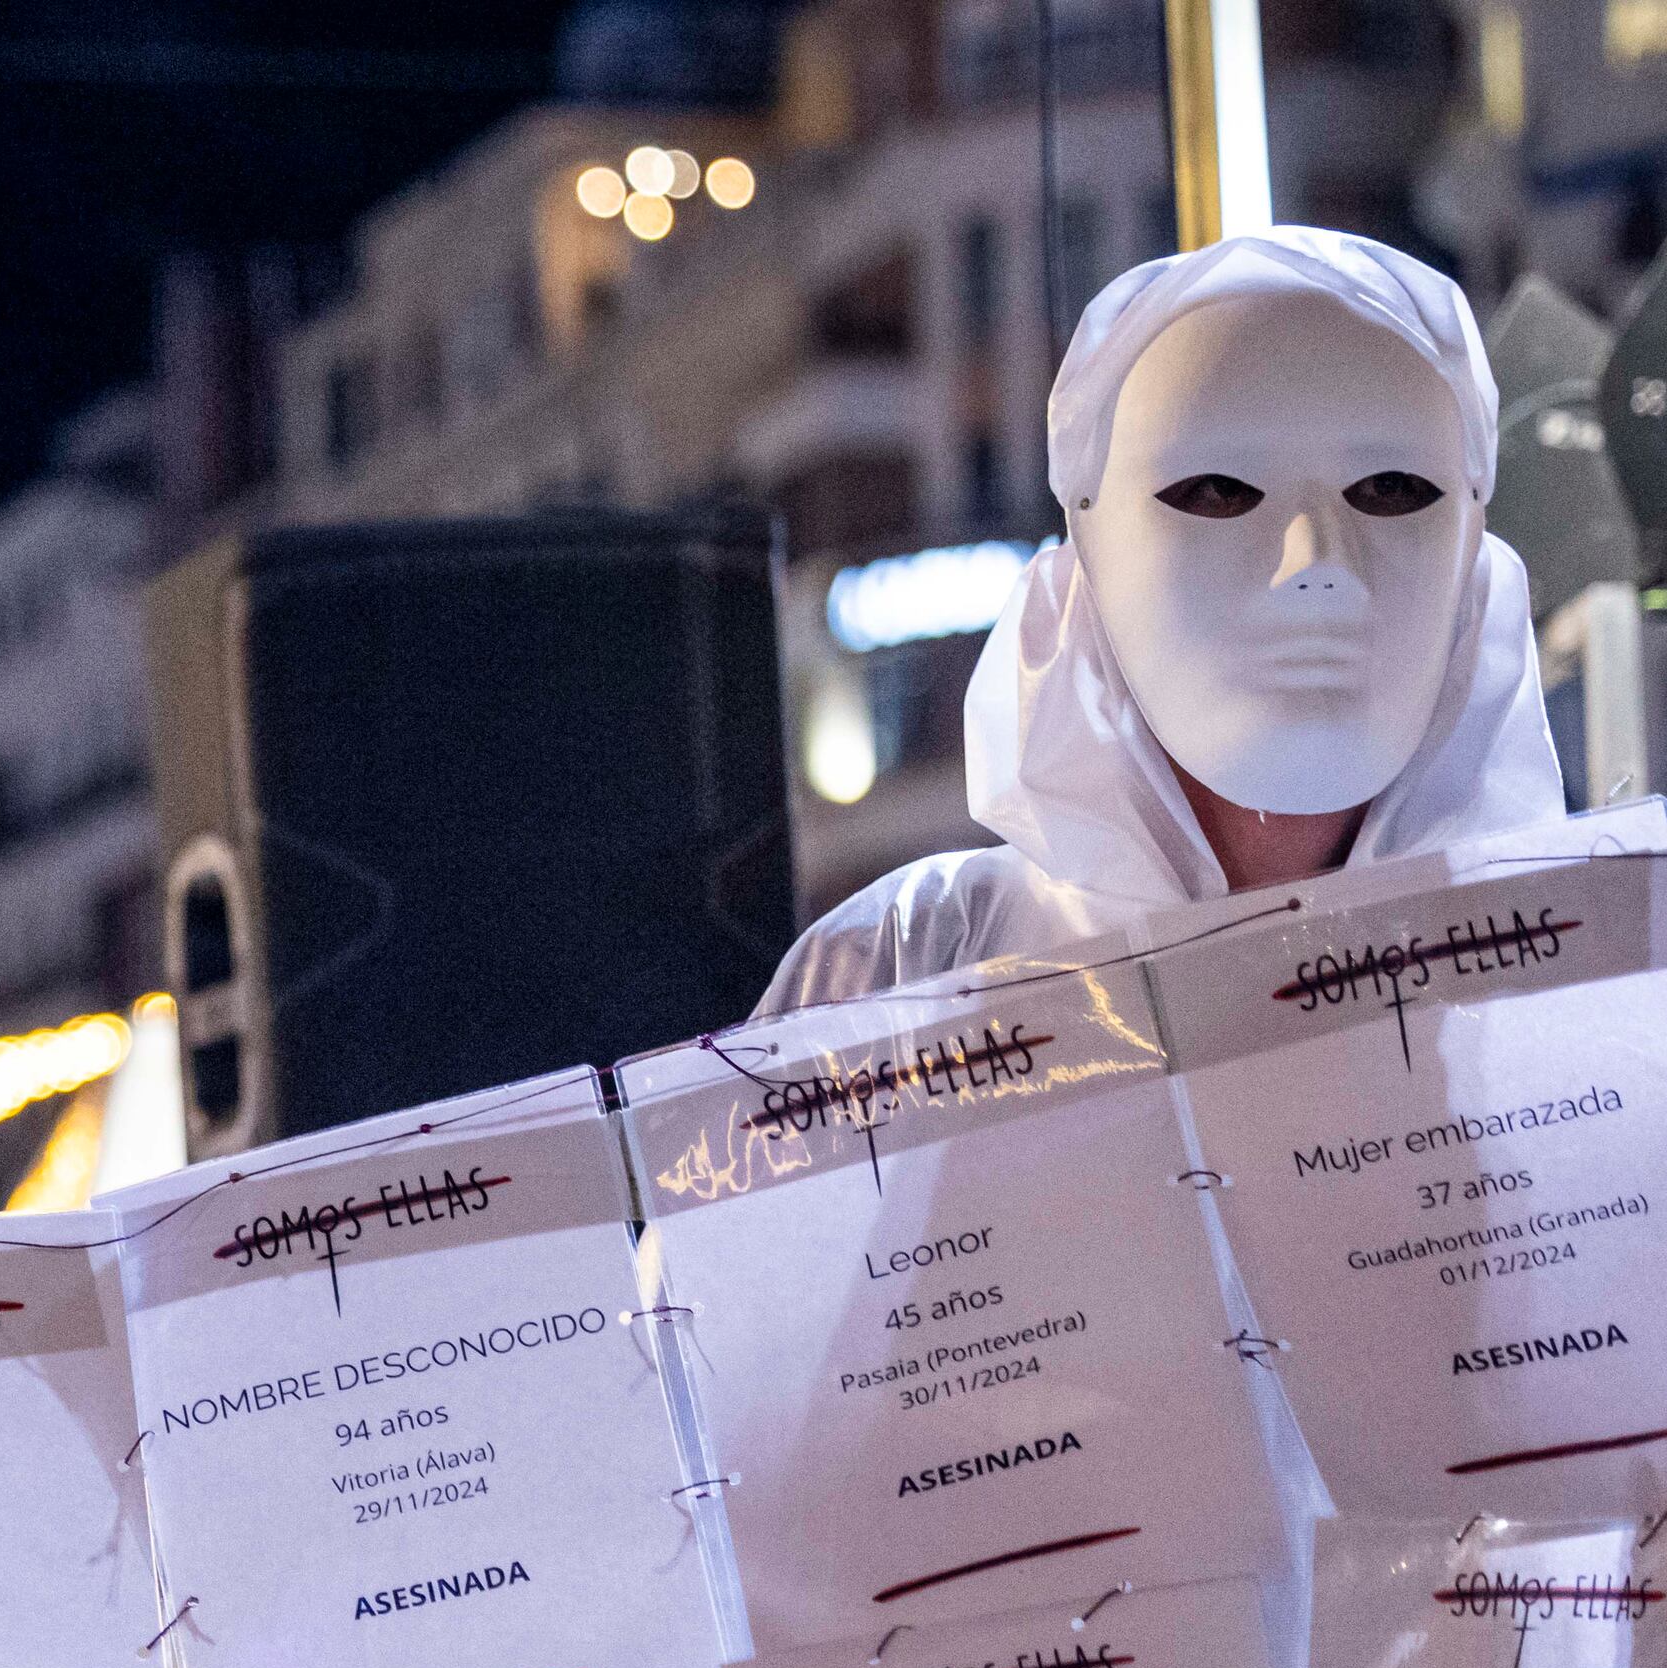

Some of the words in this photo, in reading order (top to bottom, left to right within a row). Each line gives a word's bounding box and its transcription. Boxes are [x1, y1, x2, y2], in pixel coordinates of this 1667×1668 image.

[1292, 1137, 1392, 1178] Mujer
[1404, 1085, 1624, 1154] embarazada
[864, 1226, 993, 1281] Leonor
[1346, 1223, 1524, 1272] Guadahortuna
[1528, 1193, 1651, 1236] (Granada)
[1438, 1242, 1578, 1287] 01/12/2024
[161, 1370, 324, 1434] NOMBRE
[332, 1306, 608, 1392] DESCONOCIDO
[839, 1359, 921, 1393] Pasaia
[925, 1310, 1088, 1374] (Pontevedra)
[900, 1356, 1042, 1410] 30/11/2024
[330, 1464, 411, 1495] Vitoria
[415, 1441, 497, 1477] (Álava)
[897, 1431, 1082, 1498] ASESINADA
[354, 1560, 531, 1621] ASESINADA
